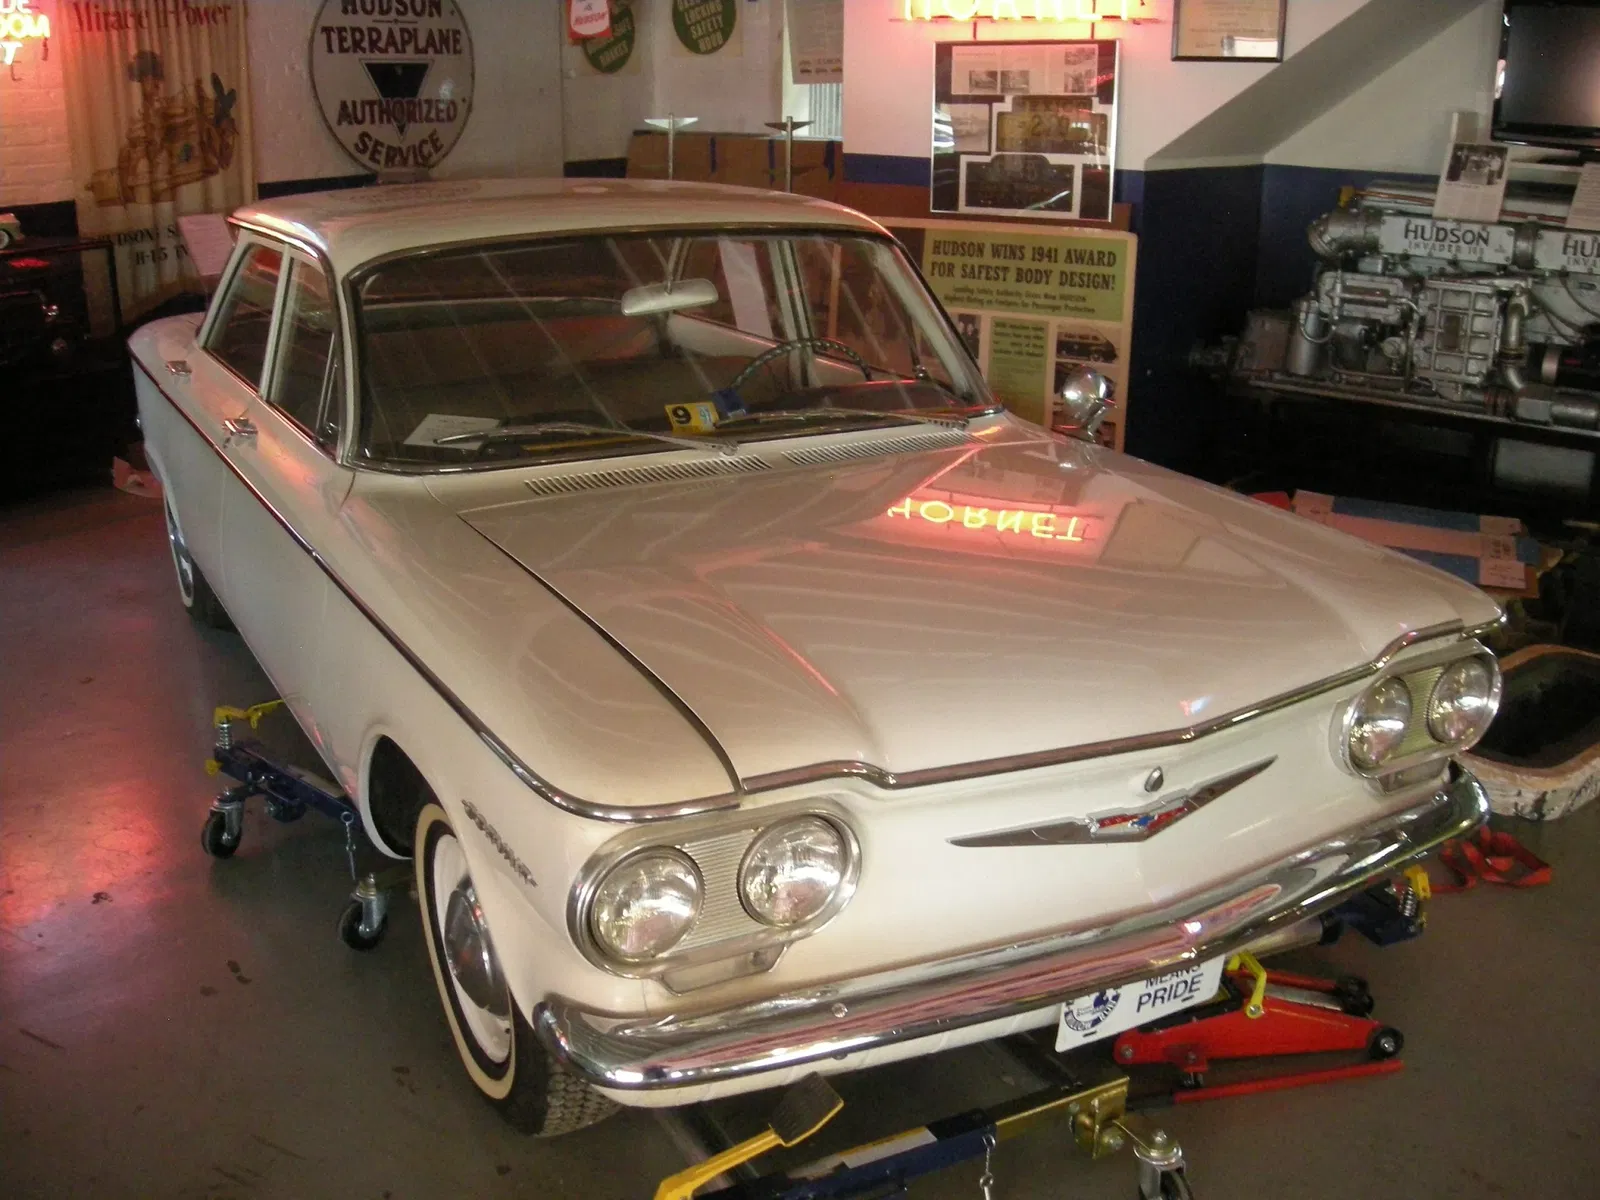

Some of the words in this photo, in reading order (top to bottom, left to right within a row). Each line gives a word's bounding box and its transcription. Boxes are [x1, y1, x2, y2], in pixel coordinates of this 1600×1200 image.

[341, 0, 442, 17] HUDSON
[320, 26, 462, 54] TERRAPLANE
[337, 97, 458, 126] AUTHORIZED
[353, 128, 444, 169] SERVICE
[1404, 220, 1490, 246] HUDSON
[933, 240, 985, 258] HUDSON
[991, 243, 1025, 261] WINS
[1031, 246, 1058, 263] 1941
[1064, 248, 1117, 267] AWARD
[1408, 240, 1461, 255] INVADER
[930, 262, 956, 277] FOR
[961, 263, 1010, 282] SAFEST
[1015, 267, 1053, 285] BODY
[1059, 270, 1116, 290] DESIGN!
[1136, 972, 1204, 1013] PRIDE
